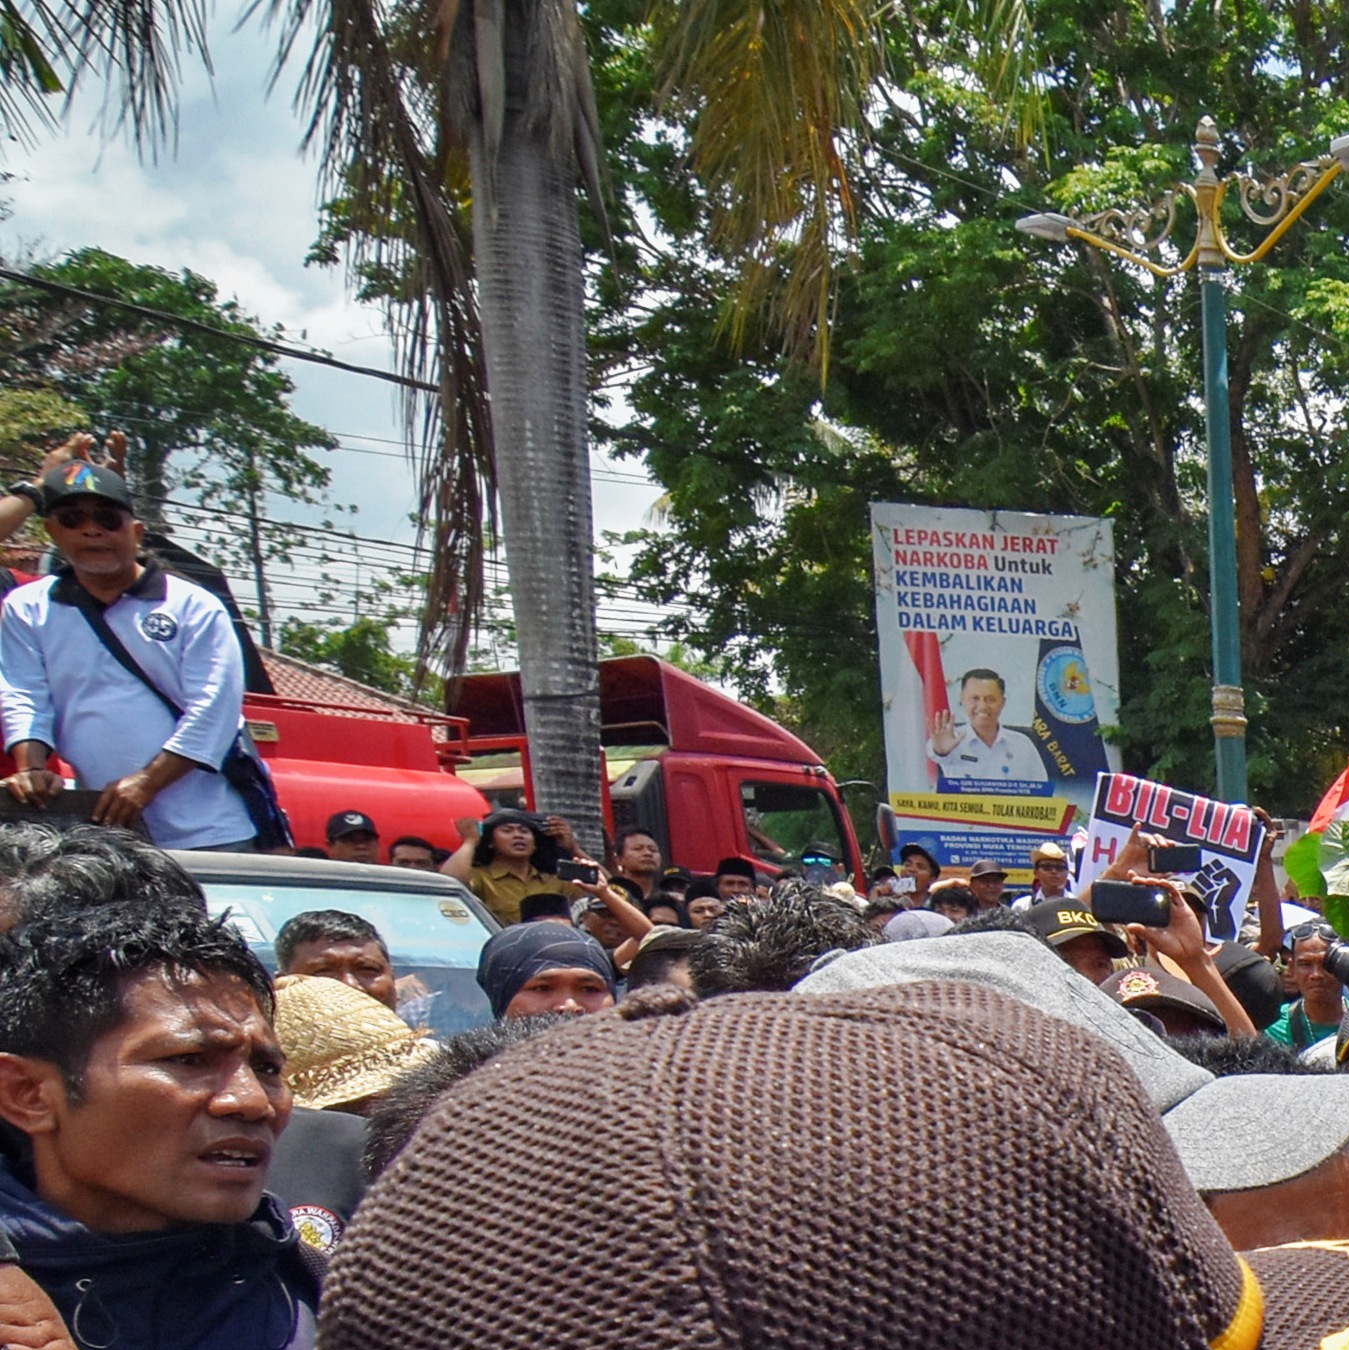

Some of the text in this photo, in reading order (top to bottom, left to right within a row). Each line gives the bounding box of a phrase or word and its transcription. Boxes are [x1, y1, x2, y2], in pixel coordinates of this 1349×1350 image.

[893, 528, 1059, 556] LEPASKAN JERAT
[894, 549, 1053, 576] NARKOBA Untuk
[895, 570, 1024, 594] KEMBALIKAN
[897, 591, 1037, 615] KEBAHAGIAAN
[898, 611, 1074, 638] DALAM KELUARGA
[1046, 740, 1076, 777] BARAT
[942, 801, 959, 812] KITA
[1105, 773, 1252, 853] BIL-LIA
